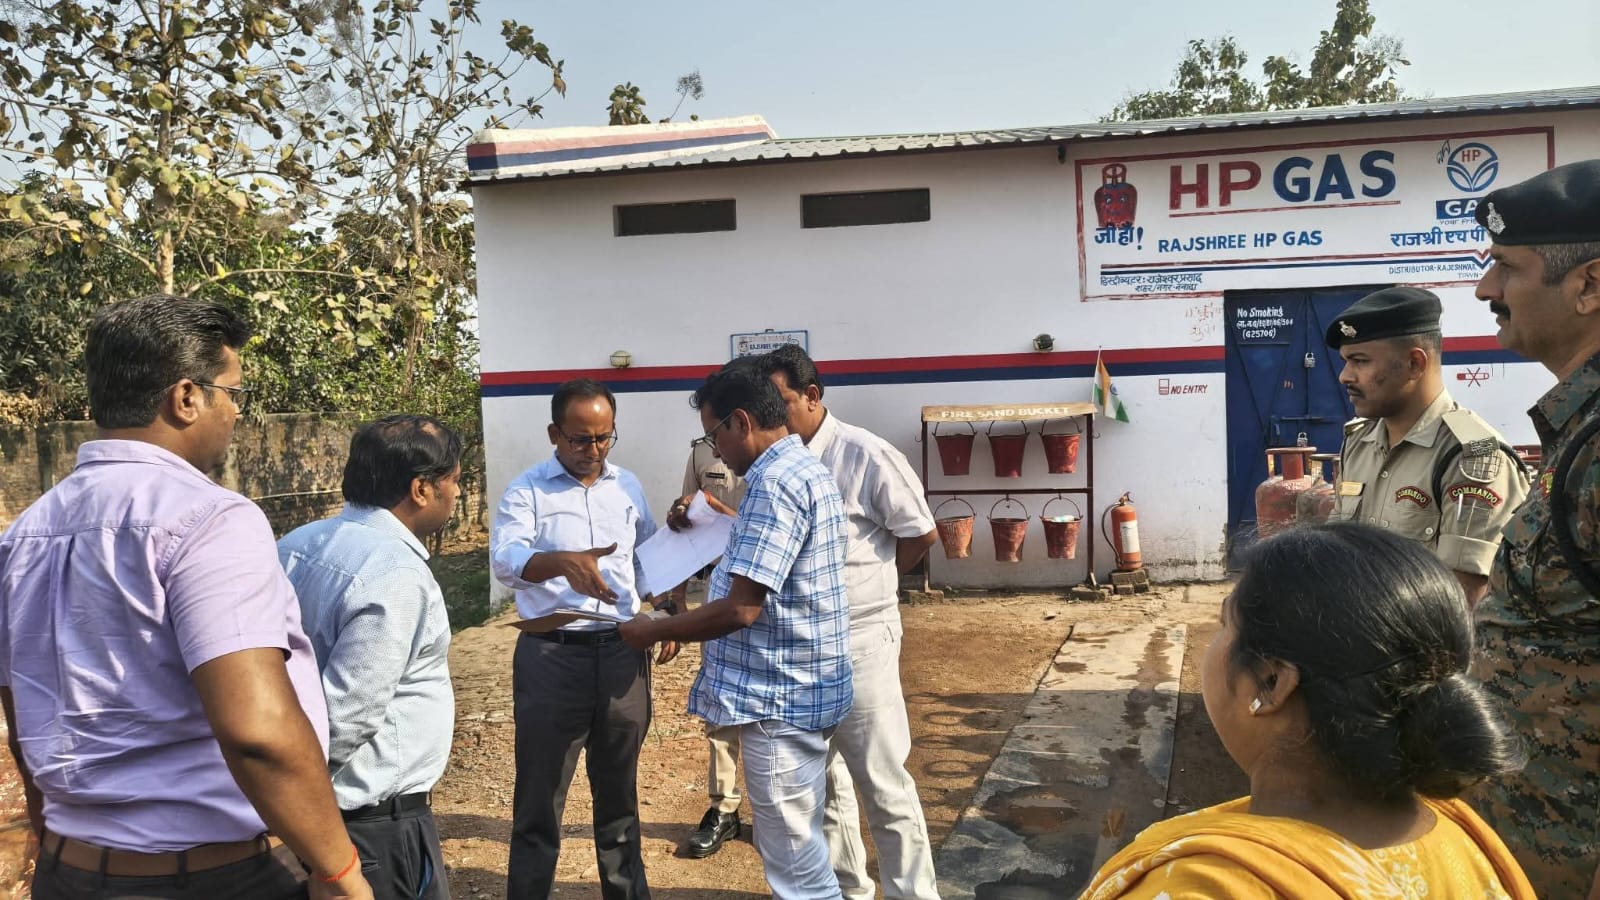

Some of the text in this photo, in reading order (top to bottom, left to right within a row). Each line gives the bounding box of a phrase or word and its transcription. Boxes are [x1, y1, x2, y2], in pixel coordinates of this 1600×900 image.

[1461, 149, 1481, 162] HP
[1169, 150, 1396, 210] HP GAS
[1445, 200, 1477, 216] GA
[1158, 230, 1323, 252] RAJSHREE HP GAS
[1237, 307, 1248, 318] No
[1170, 384, 1208, 395] NO ENTRY
[941, 406, 1071, 418] FIRE SAND BUCKET
[1451, 484, 1499, 505] COMMANDO
